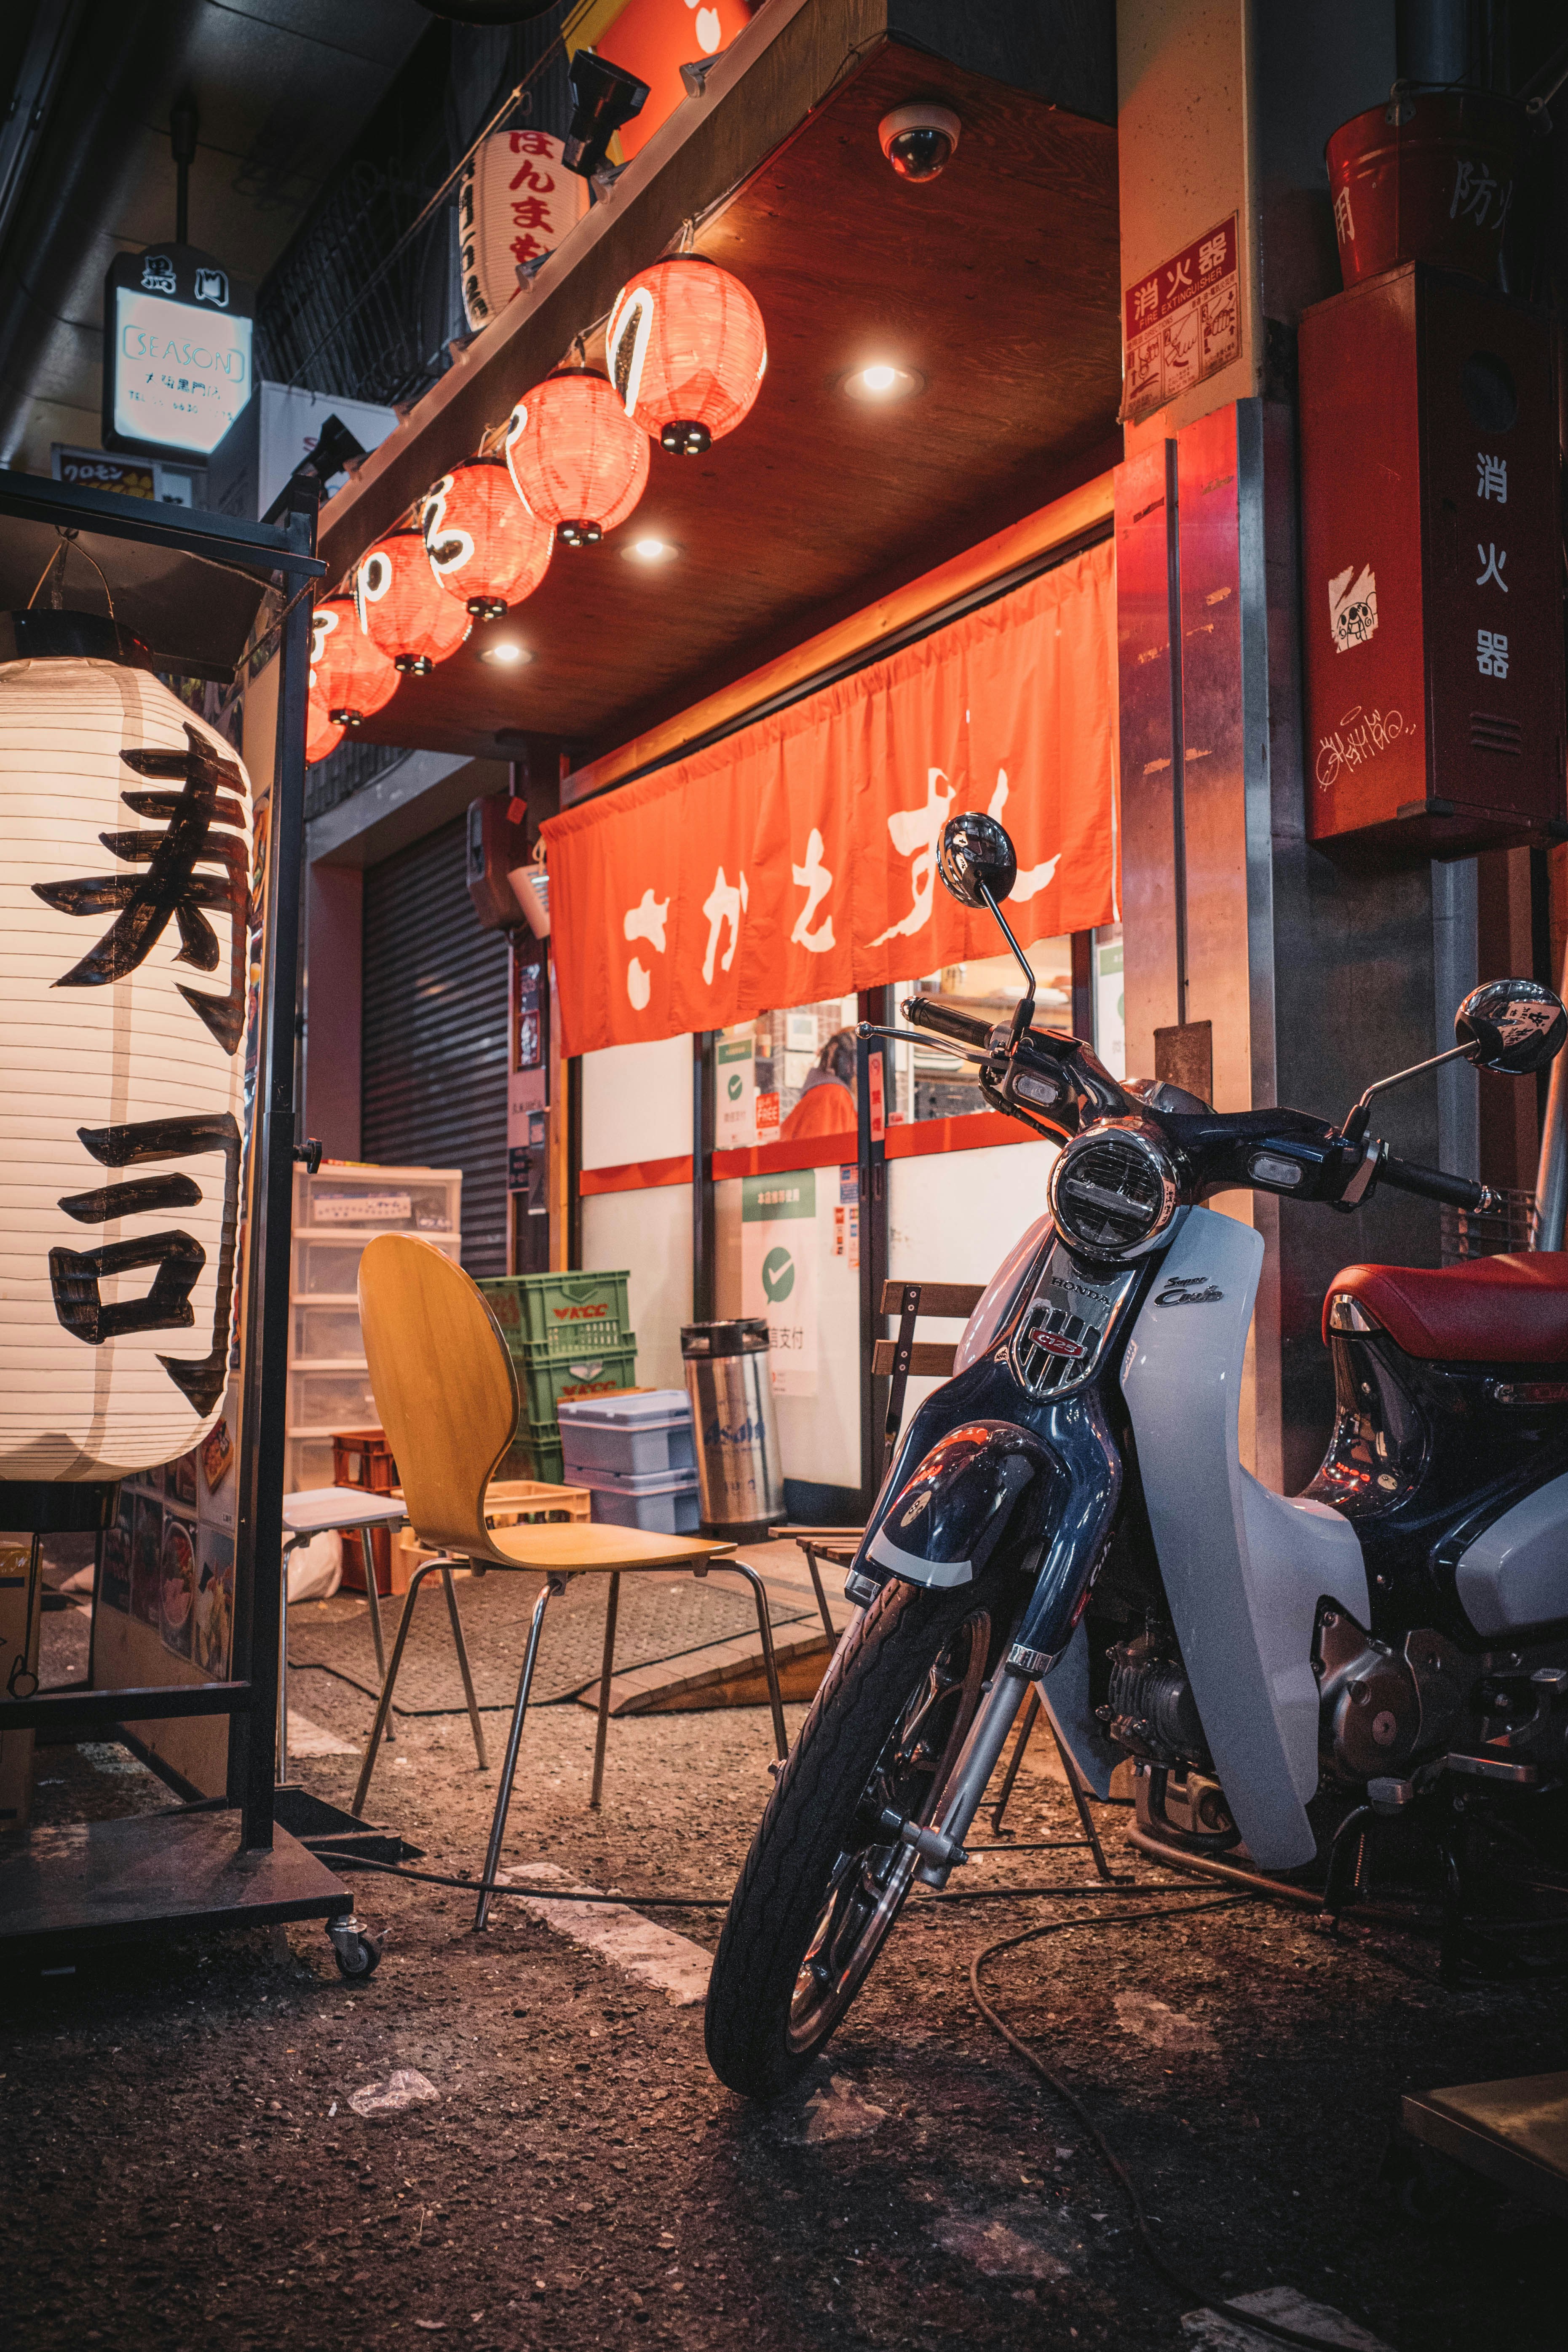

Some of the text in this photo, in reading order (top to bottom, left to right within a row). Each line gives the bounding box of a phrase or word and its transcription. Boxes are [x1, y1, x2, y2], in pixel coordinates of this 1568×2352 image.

[1134, 231, 1227, 321] 消火器
[1139, 267, 1223, 331] FIRE EXTINGUISHER
[137, 333, 232, 375] SEASON
[64, 464, 123, 482] クロモン
[1476, 452, 1509, 679] 消火器
[31, 721, 253, 1418] 寿司
[1051, 1276, 1111, 1307] HONDA
[1154, 1285, 1224, 1308] Cub
[1164, 1276, 1209, 1289] Super
[1037, 1334, 1077, 1353] C125
